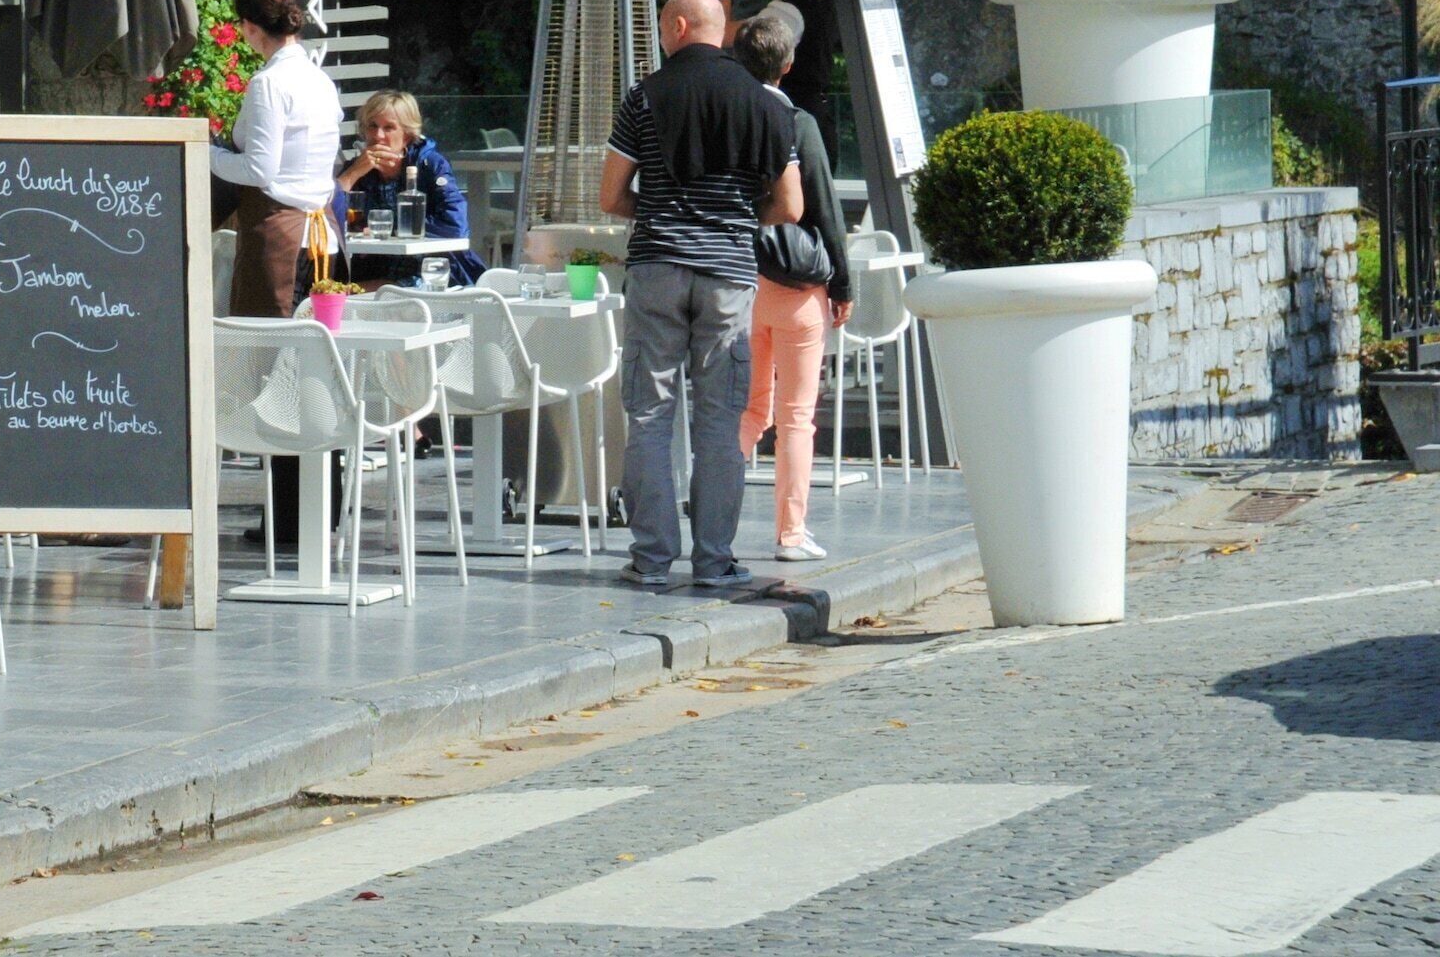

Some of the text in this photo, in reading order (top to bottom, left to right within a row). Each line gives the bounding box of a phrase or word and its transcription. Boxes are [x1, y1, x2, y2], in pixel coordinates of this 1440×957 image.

[16, 158, 78, 195] lunch
[82, 168, 106, 195] du
[96, 174, 150, 212] jour
[115, 192, 162, 217] 18€
[53, 380, 76, 405] de
[7, 416, 30, 429] au
[37, 410, 89, 431] beurre
